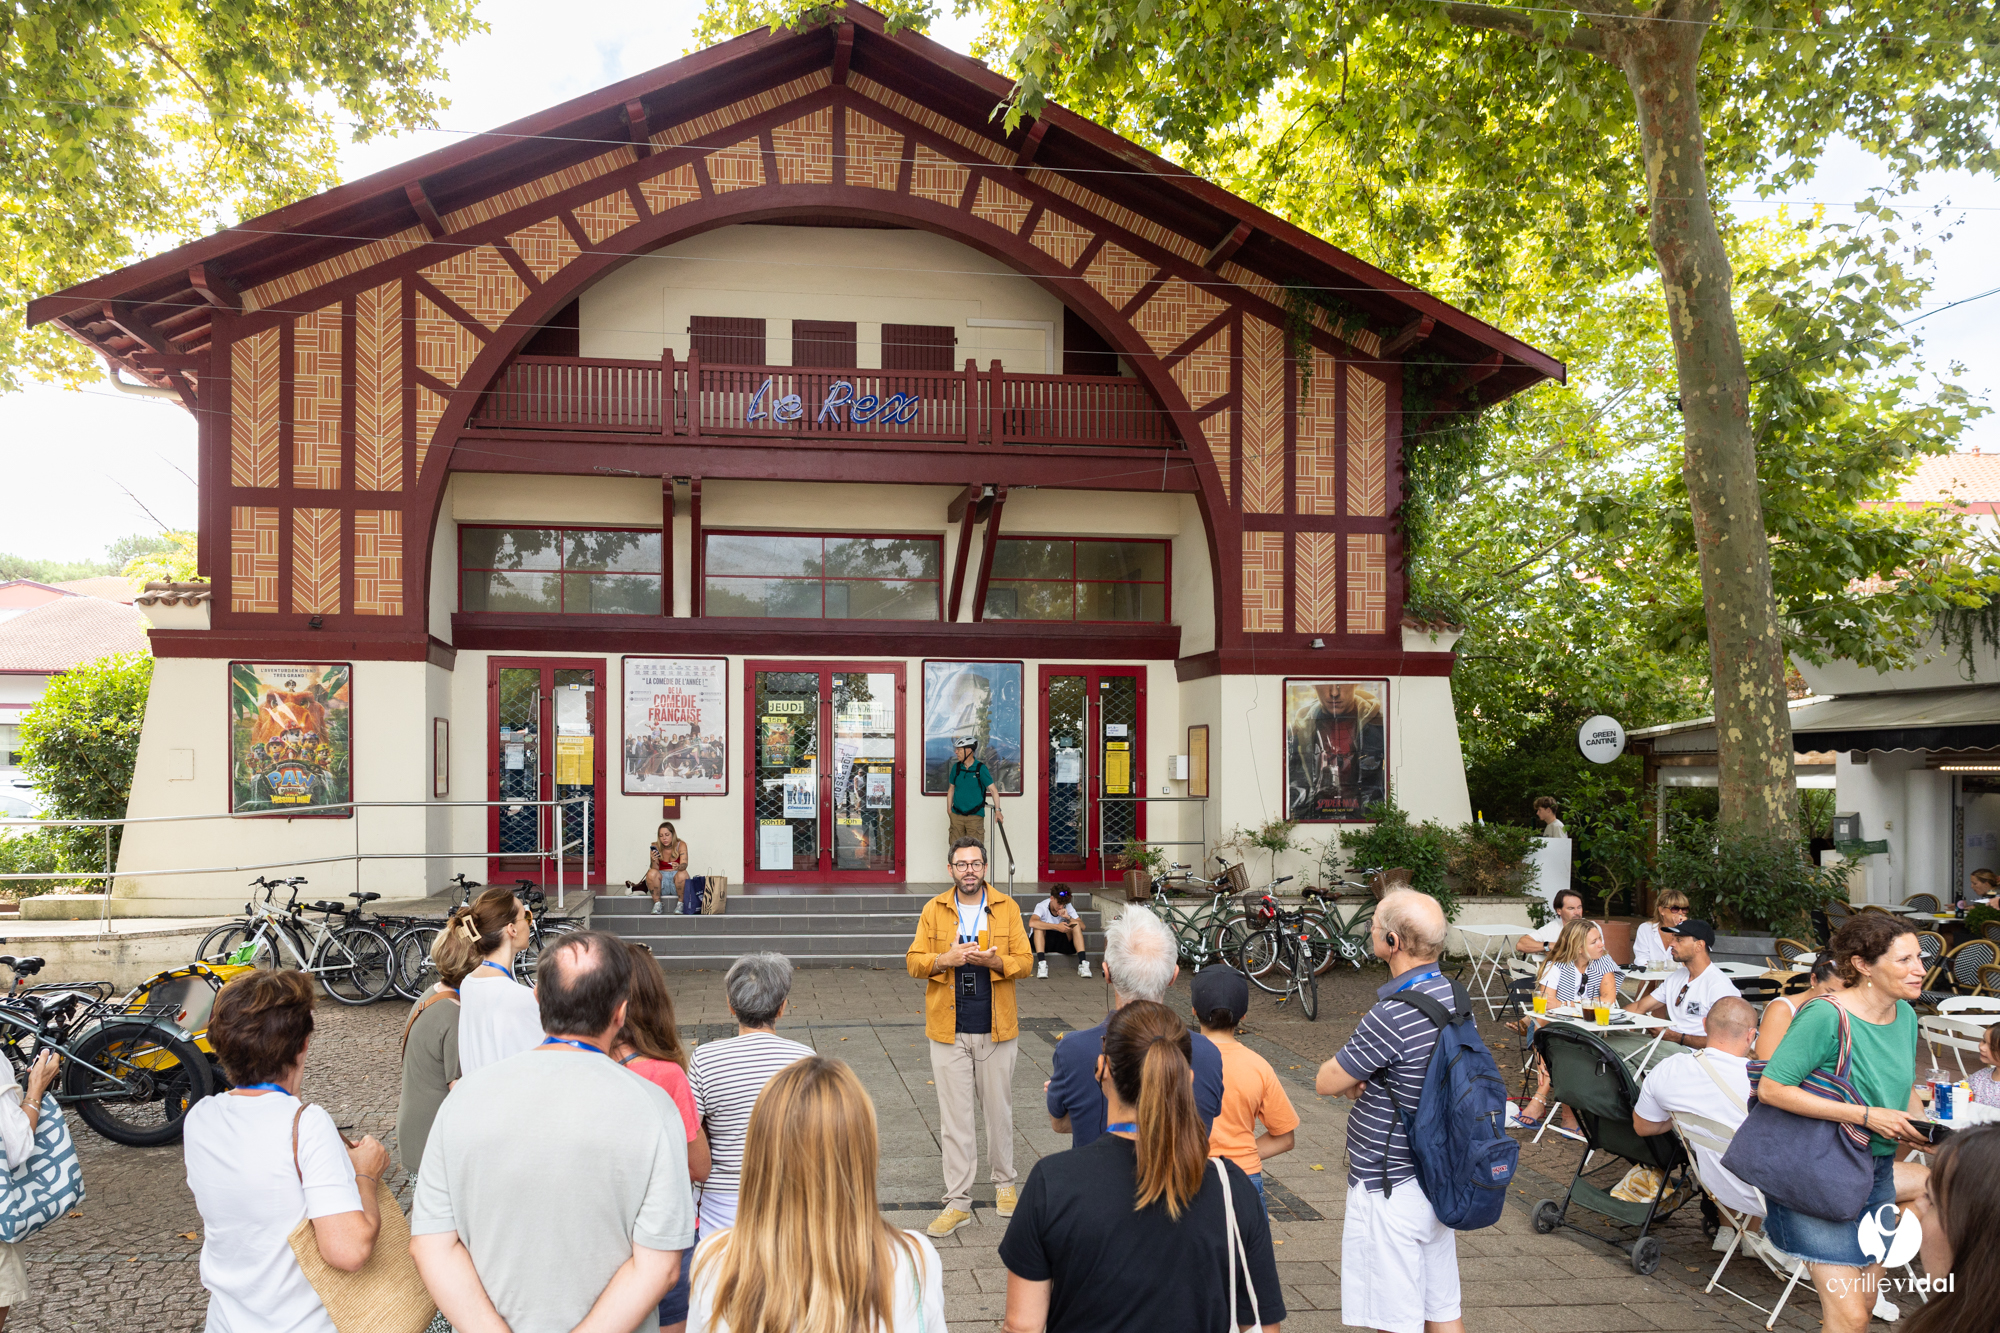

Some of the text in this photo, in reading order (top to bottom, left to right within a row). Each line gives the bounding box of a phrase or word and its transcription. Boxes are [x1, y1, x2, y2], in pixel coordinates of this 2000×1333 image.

[747, 379, 920, 424] Le Rex
[653, 677, 674, 686] COMÉDIE
[675, 678, 682, 686] DE
[682, 678, 702, 686] L'ANNÉE
[668, 686, 675, 694] DE
[648, 708, 702, 724] FRANÇAISE
[1586, 737, 1617, 745] CANTINE
[266, 770, 316, 789] PAW
